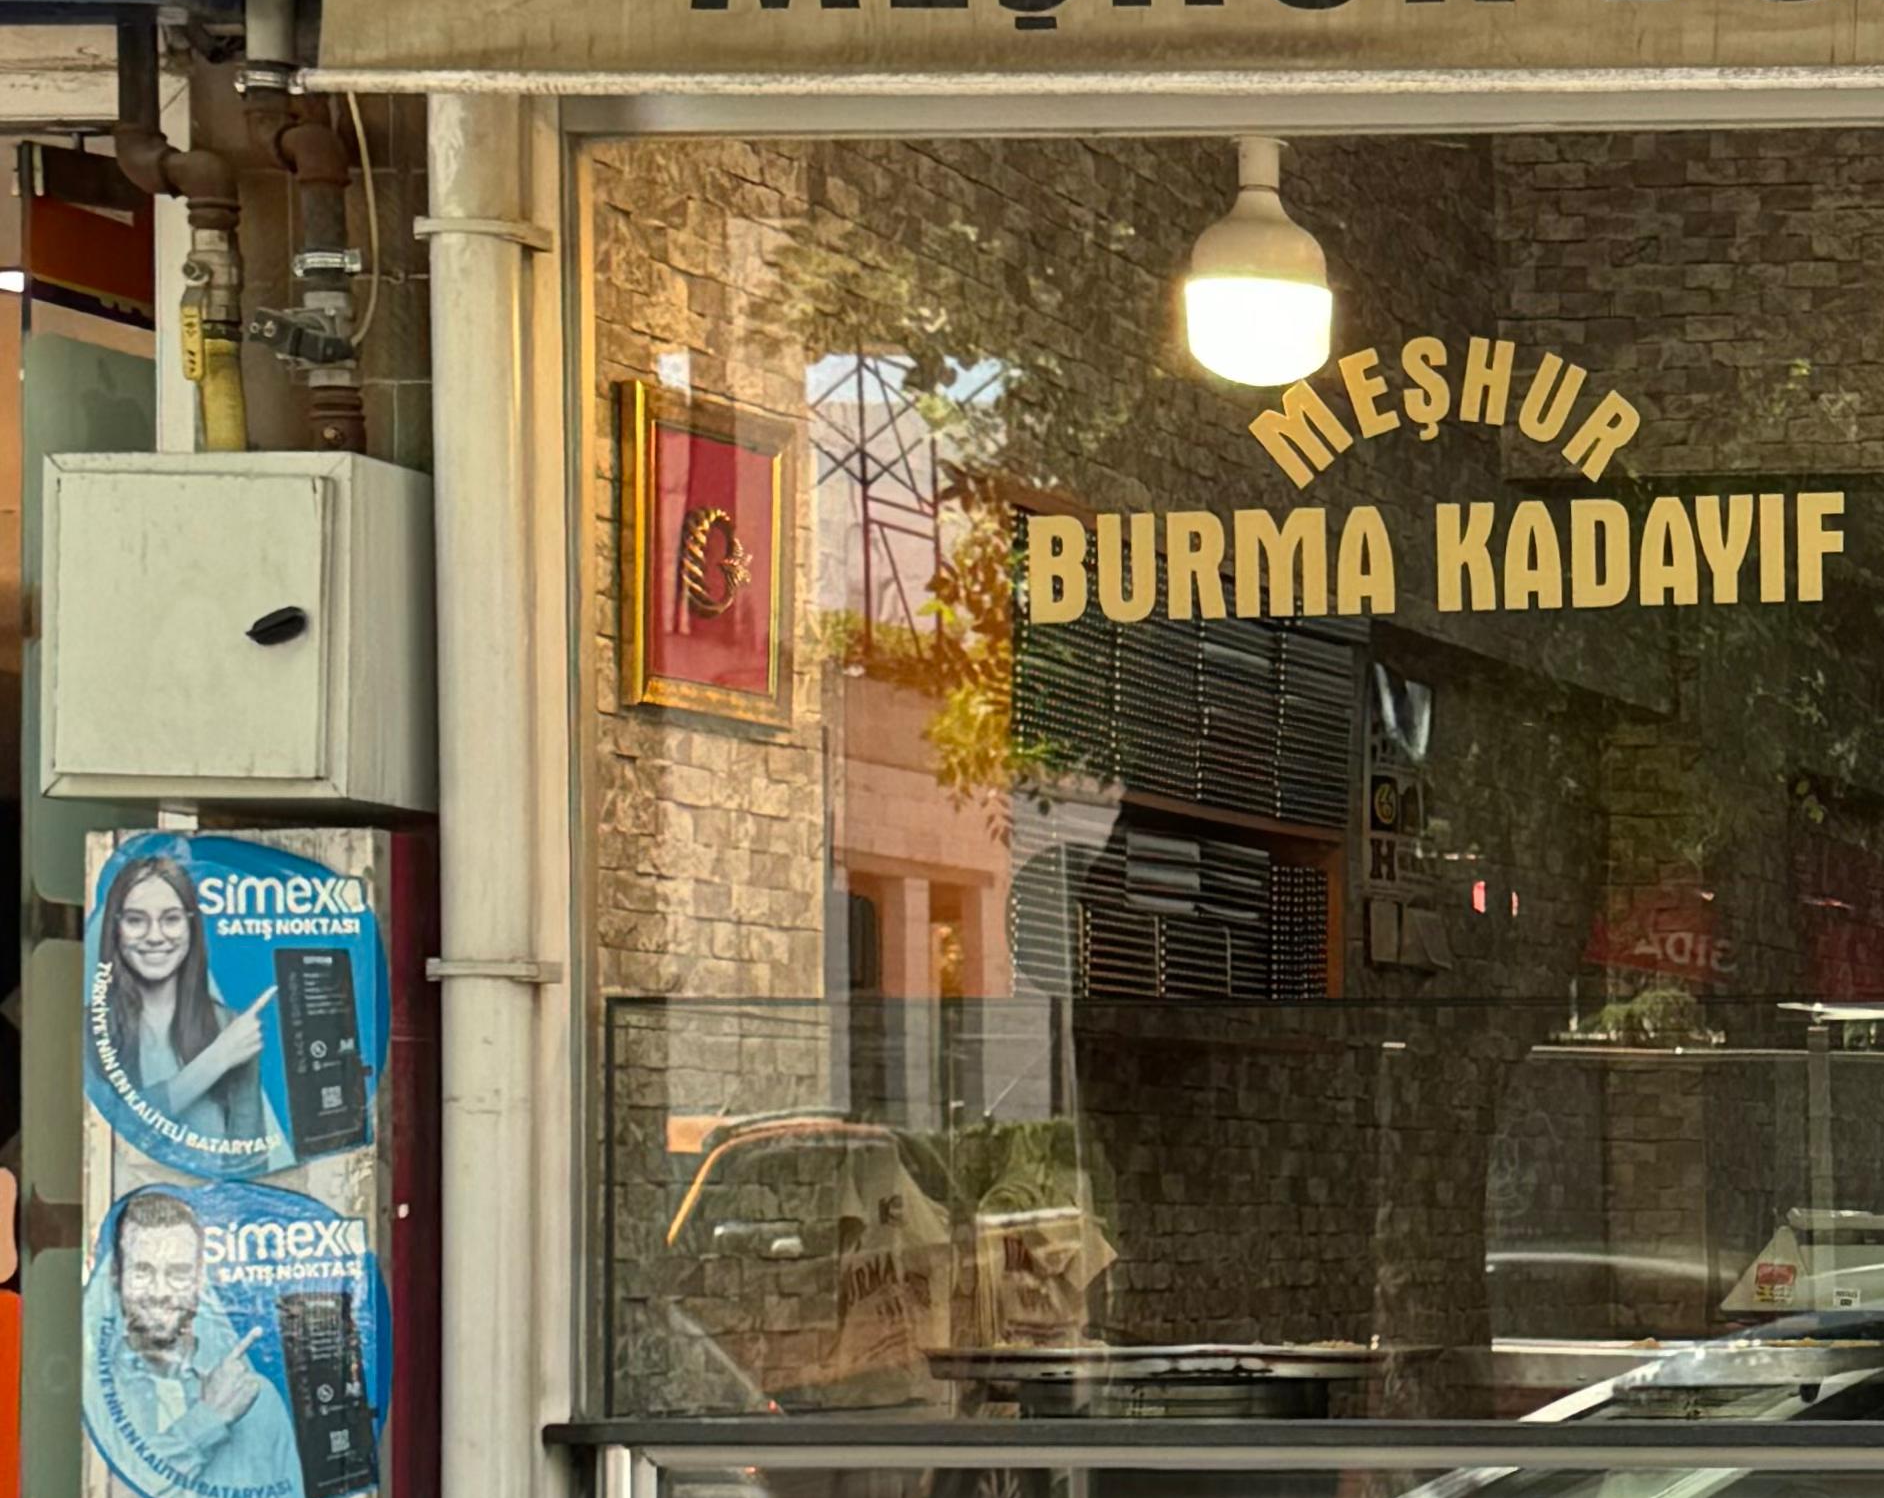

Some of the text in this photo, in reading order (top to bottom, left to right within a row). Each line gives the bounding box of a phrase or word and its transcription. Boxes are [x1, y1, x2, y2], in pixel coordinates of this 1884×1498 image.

[1248, 336, 1642, 490] MEŞHUR
[1026, 491, 1846, 626] BURMA KADAYIF
[198, 874, 340, 915] simex
[217, 918, 361, 941] SATIŞ NOKTASI
[202, 1220, 342, 1264] simex
